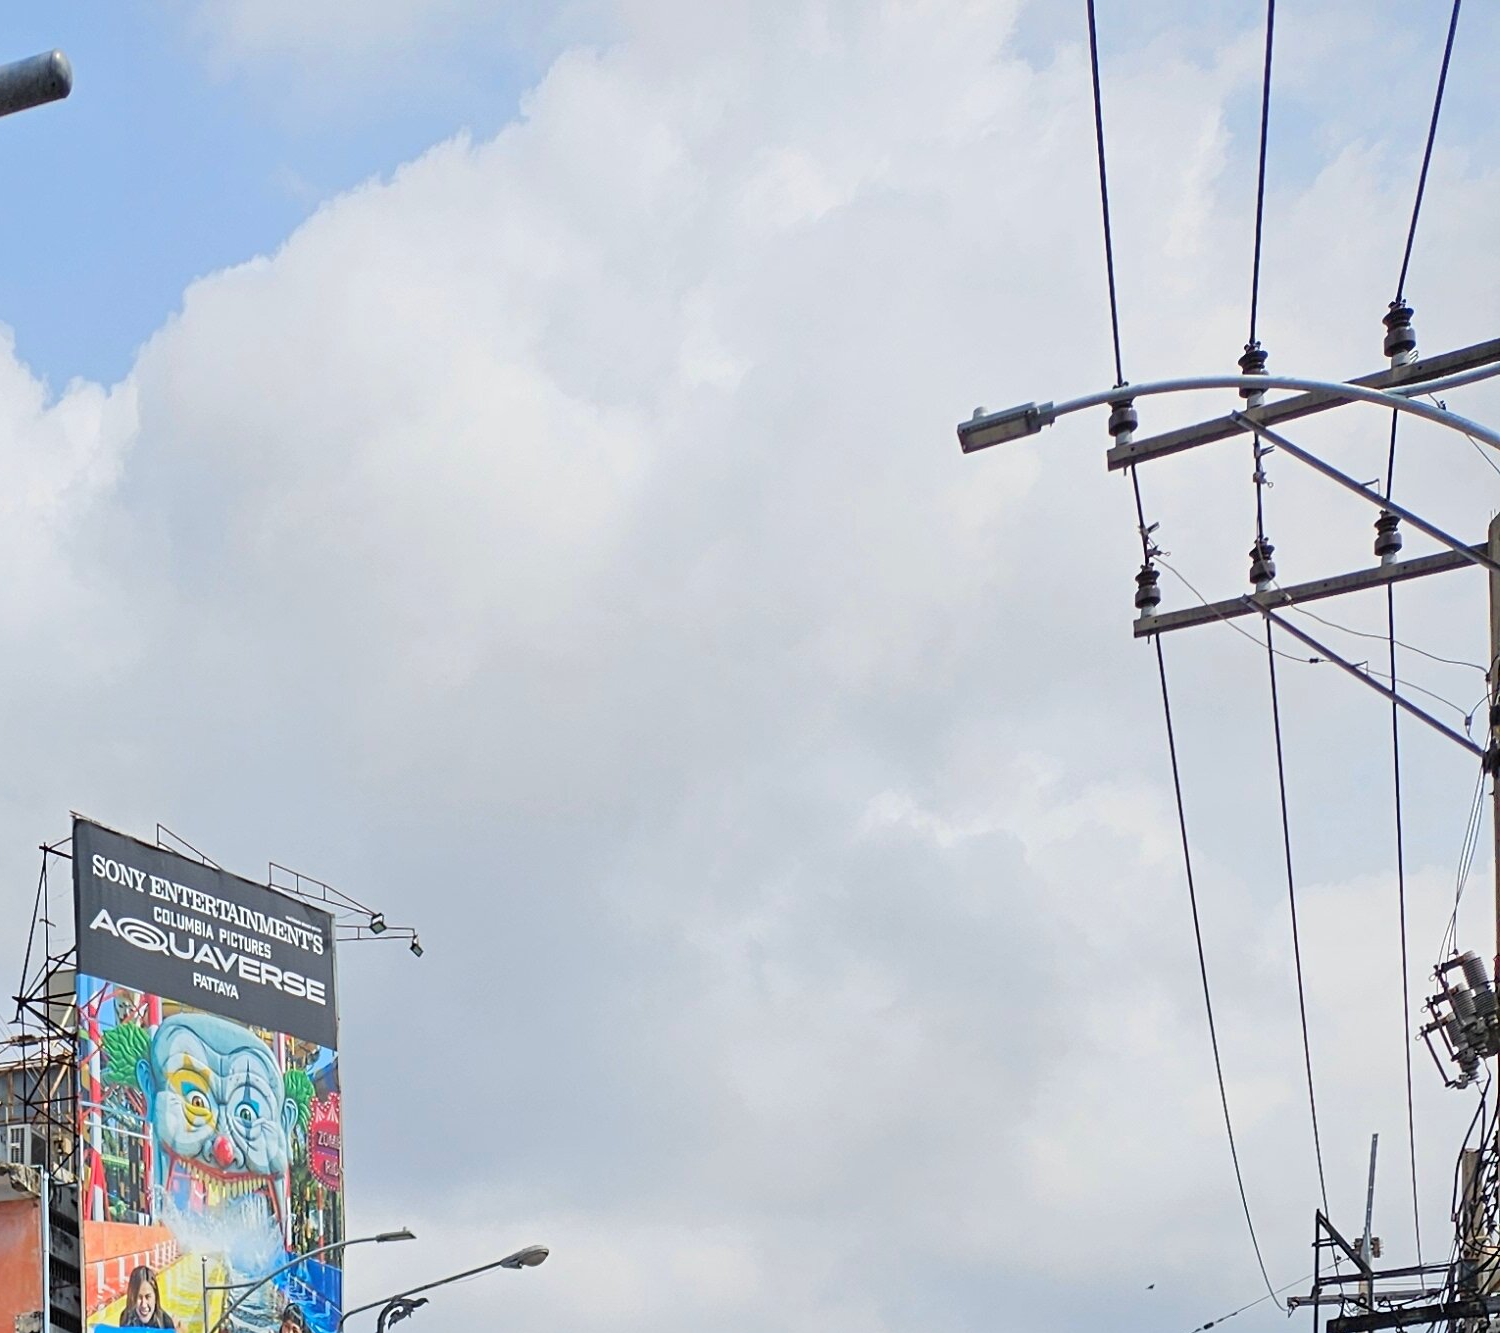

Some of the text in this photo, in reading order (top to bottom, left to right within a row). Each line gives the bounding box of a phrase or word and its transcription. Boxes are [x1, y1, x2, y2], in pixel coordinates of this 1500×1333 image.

[92, 854, 323, 956] SONY ENTERTAINMENT'S
[153, 906, 272, 960] COLUMBIA PICTURES
[89, 909, 326, 1006] AQUAVERSE
[192, 972, 239, 1000] PATTAYA
